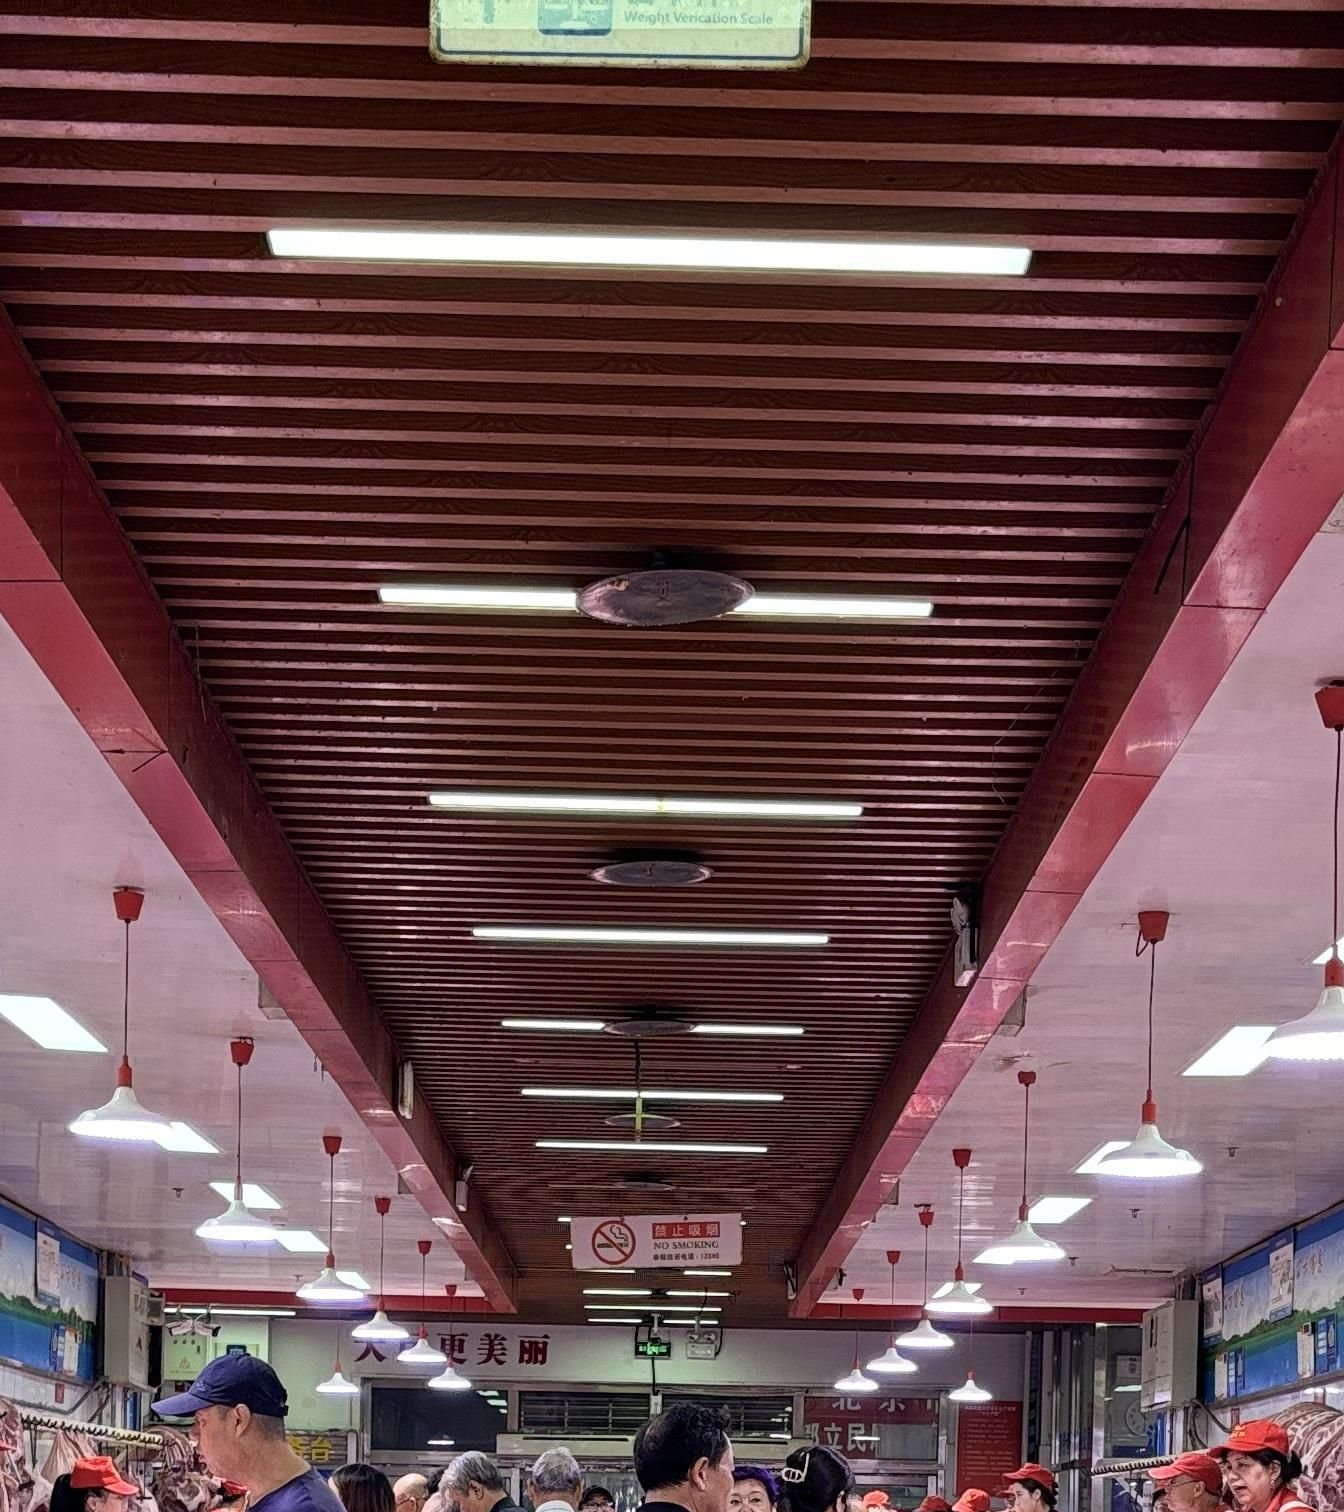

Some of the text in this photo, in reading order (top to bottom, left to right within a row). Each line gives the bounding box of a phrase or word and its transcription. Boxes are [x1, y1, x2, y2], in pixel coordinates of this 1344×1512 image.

[624, 10, 670, 26] Weight
[741, 12, 773, 25] Scale
[655, 1223, 719, 1238] 禁止吸烟
[654, 1240, 719, 1250] NO SMOKING
